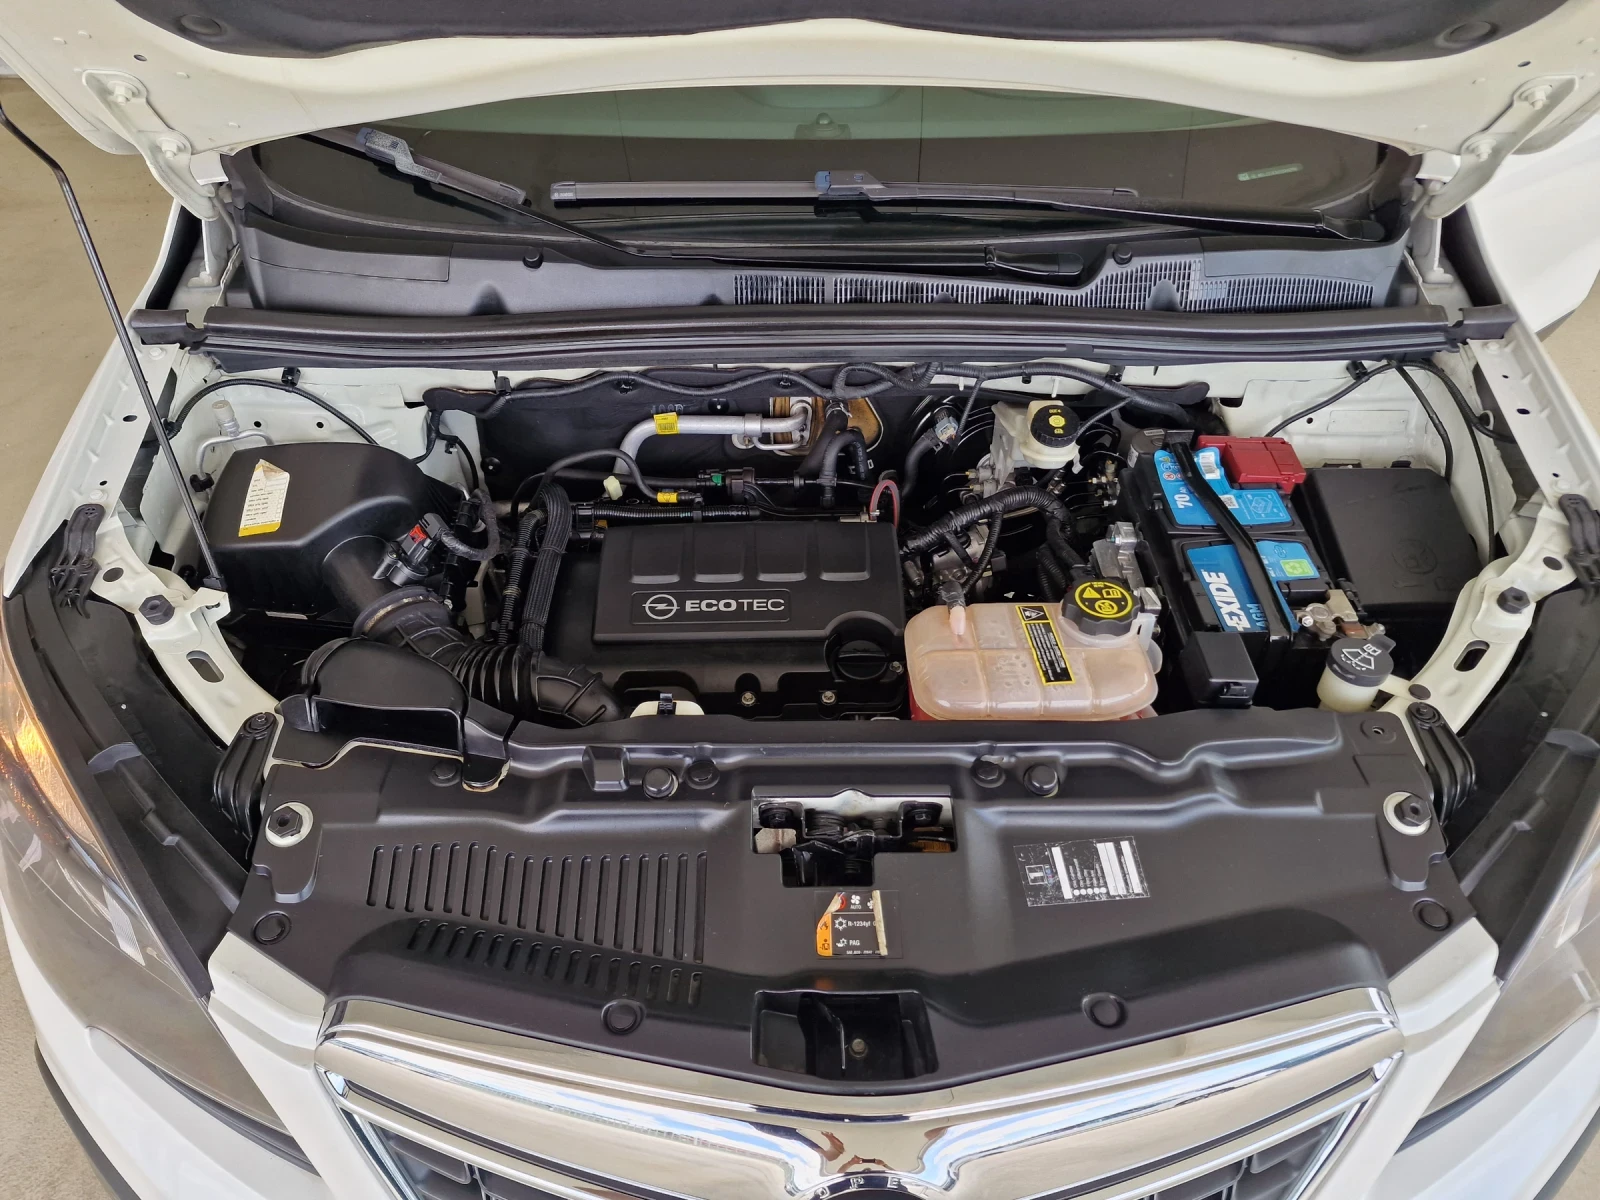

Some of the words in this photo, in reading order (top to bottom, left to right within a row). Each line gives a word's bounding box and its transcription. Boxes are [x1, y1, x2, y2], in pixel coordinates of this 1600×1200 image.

[1173, 494, 1193, 509] 70
[685, 598, 785, 612] ECOTEC
[1201, 571, 1251, 632] EXIDE
[847, 920, 871, 928] R-1234yf
